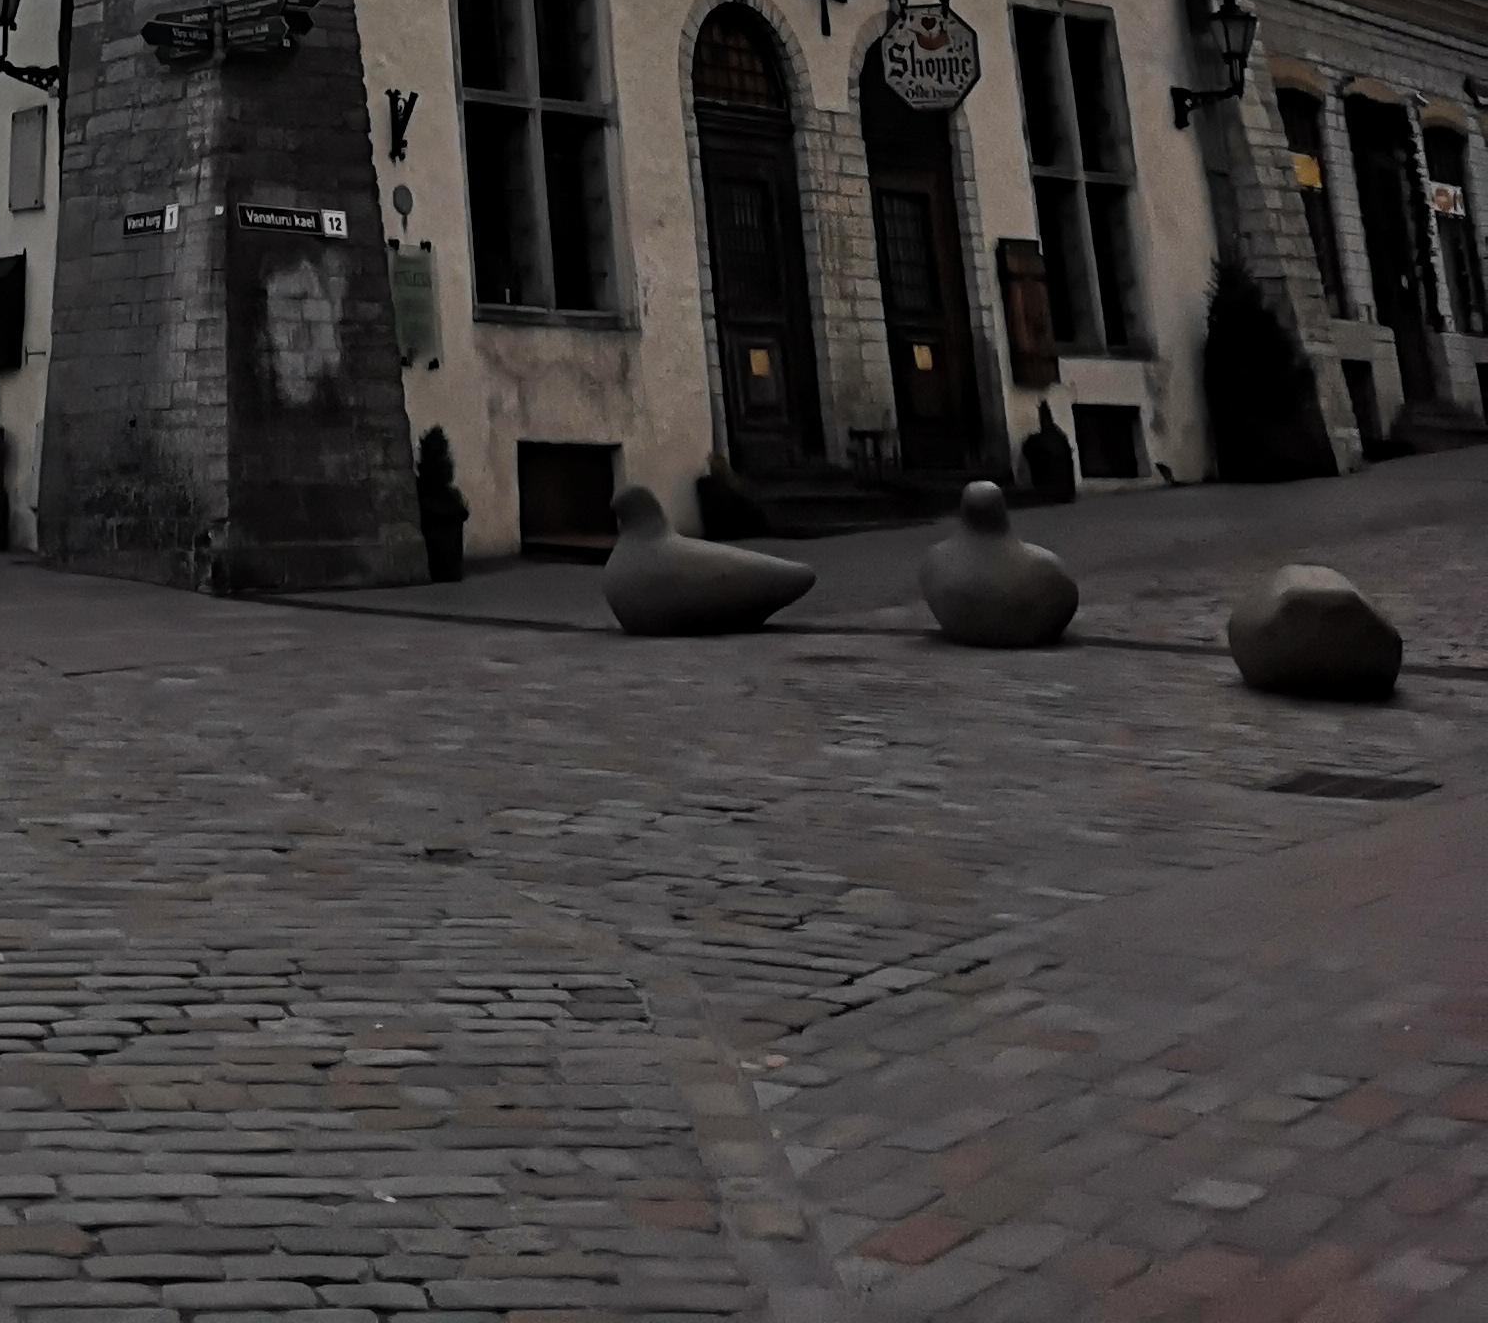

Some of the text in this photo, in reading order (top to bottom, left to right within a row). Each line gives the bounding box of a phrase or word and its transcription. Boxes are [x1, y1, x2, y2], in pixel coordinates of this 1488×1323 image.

[888, 40, 971, 84] Shoppe
[246, 210, 342, 232] Vanaturu kael 12
